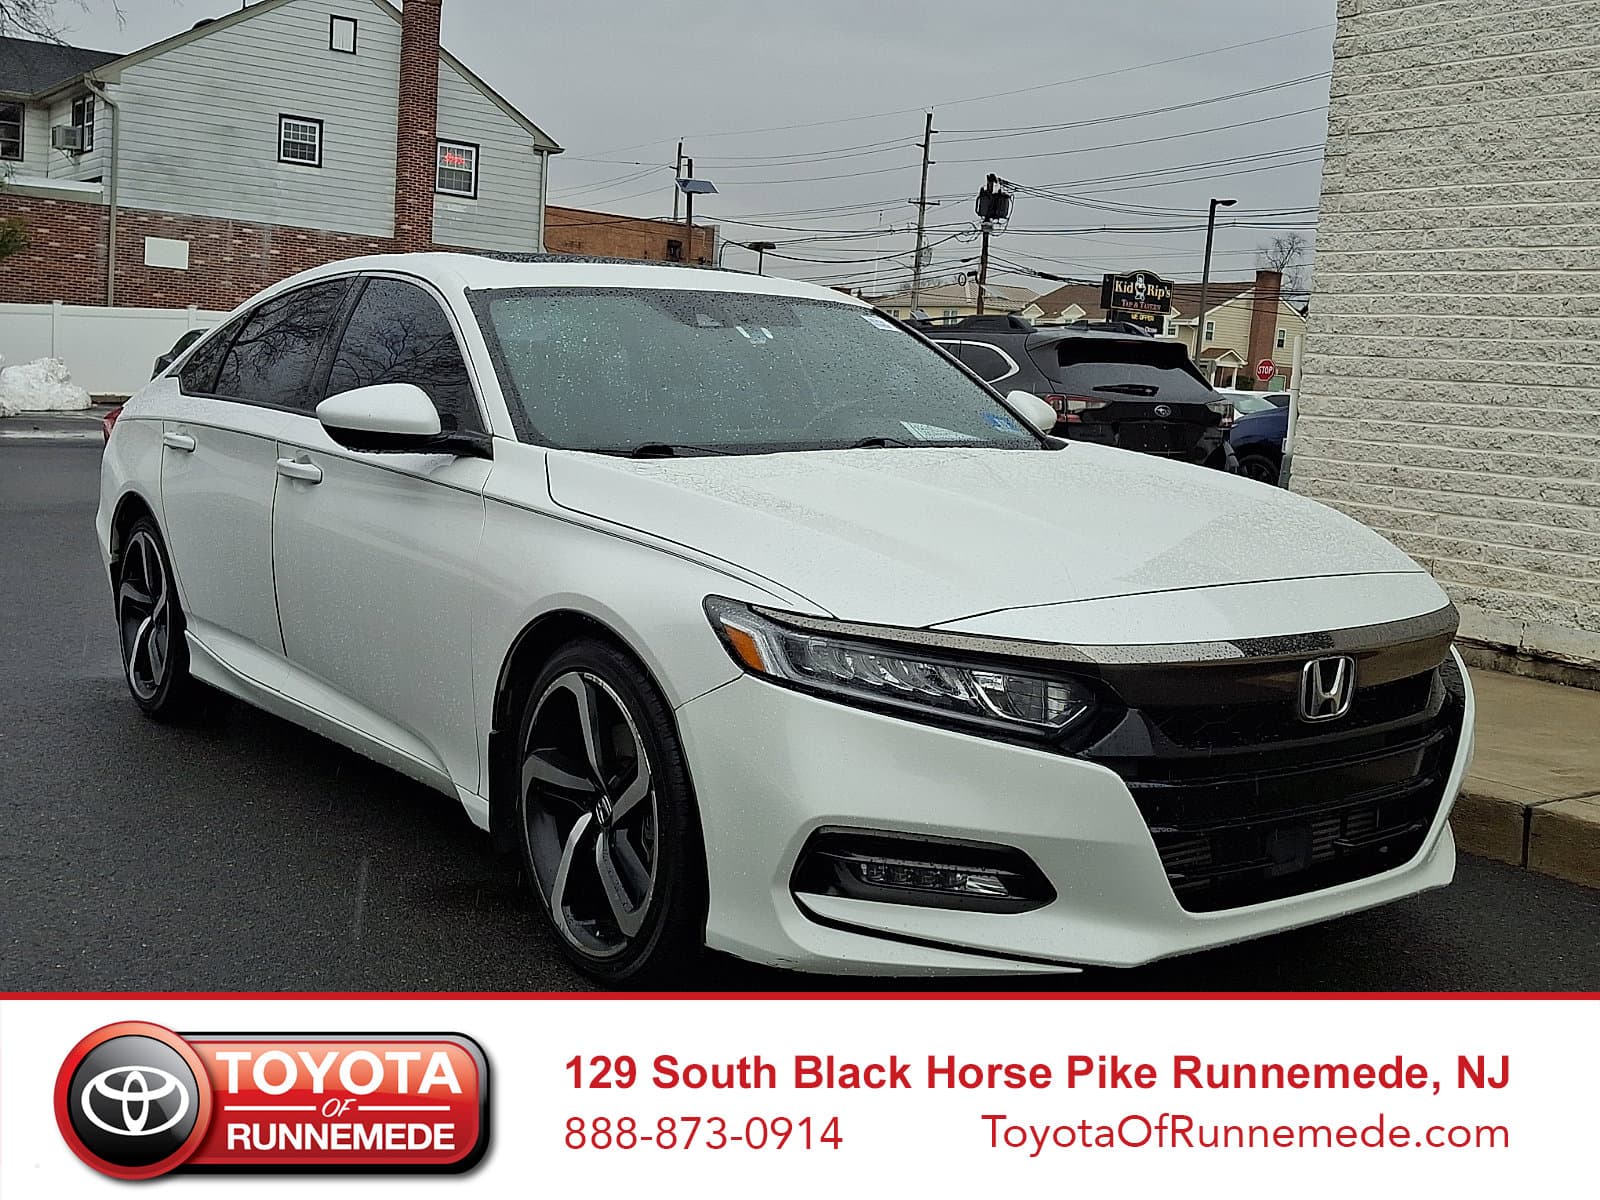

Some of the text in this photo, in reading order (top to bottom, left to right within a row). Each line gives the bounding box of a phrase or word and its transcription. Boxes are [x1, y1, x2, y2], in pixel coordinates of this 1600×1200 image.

[1115, 280, 1171, 300] Kid Rip's
[1258, 365, 1273, 375] STOP
